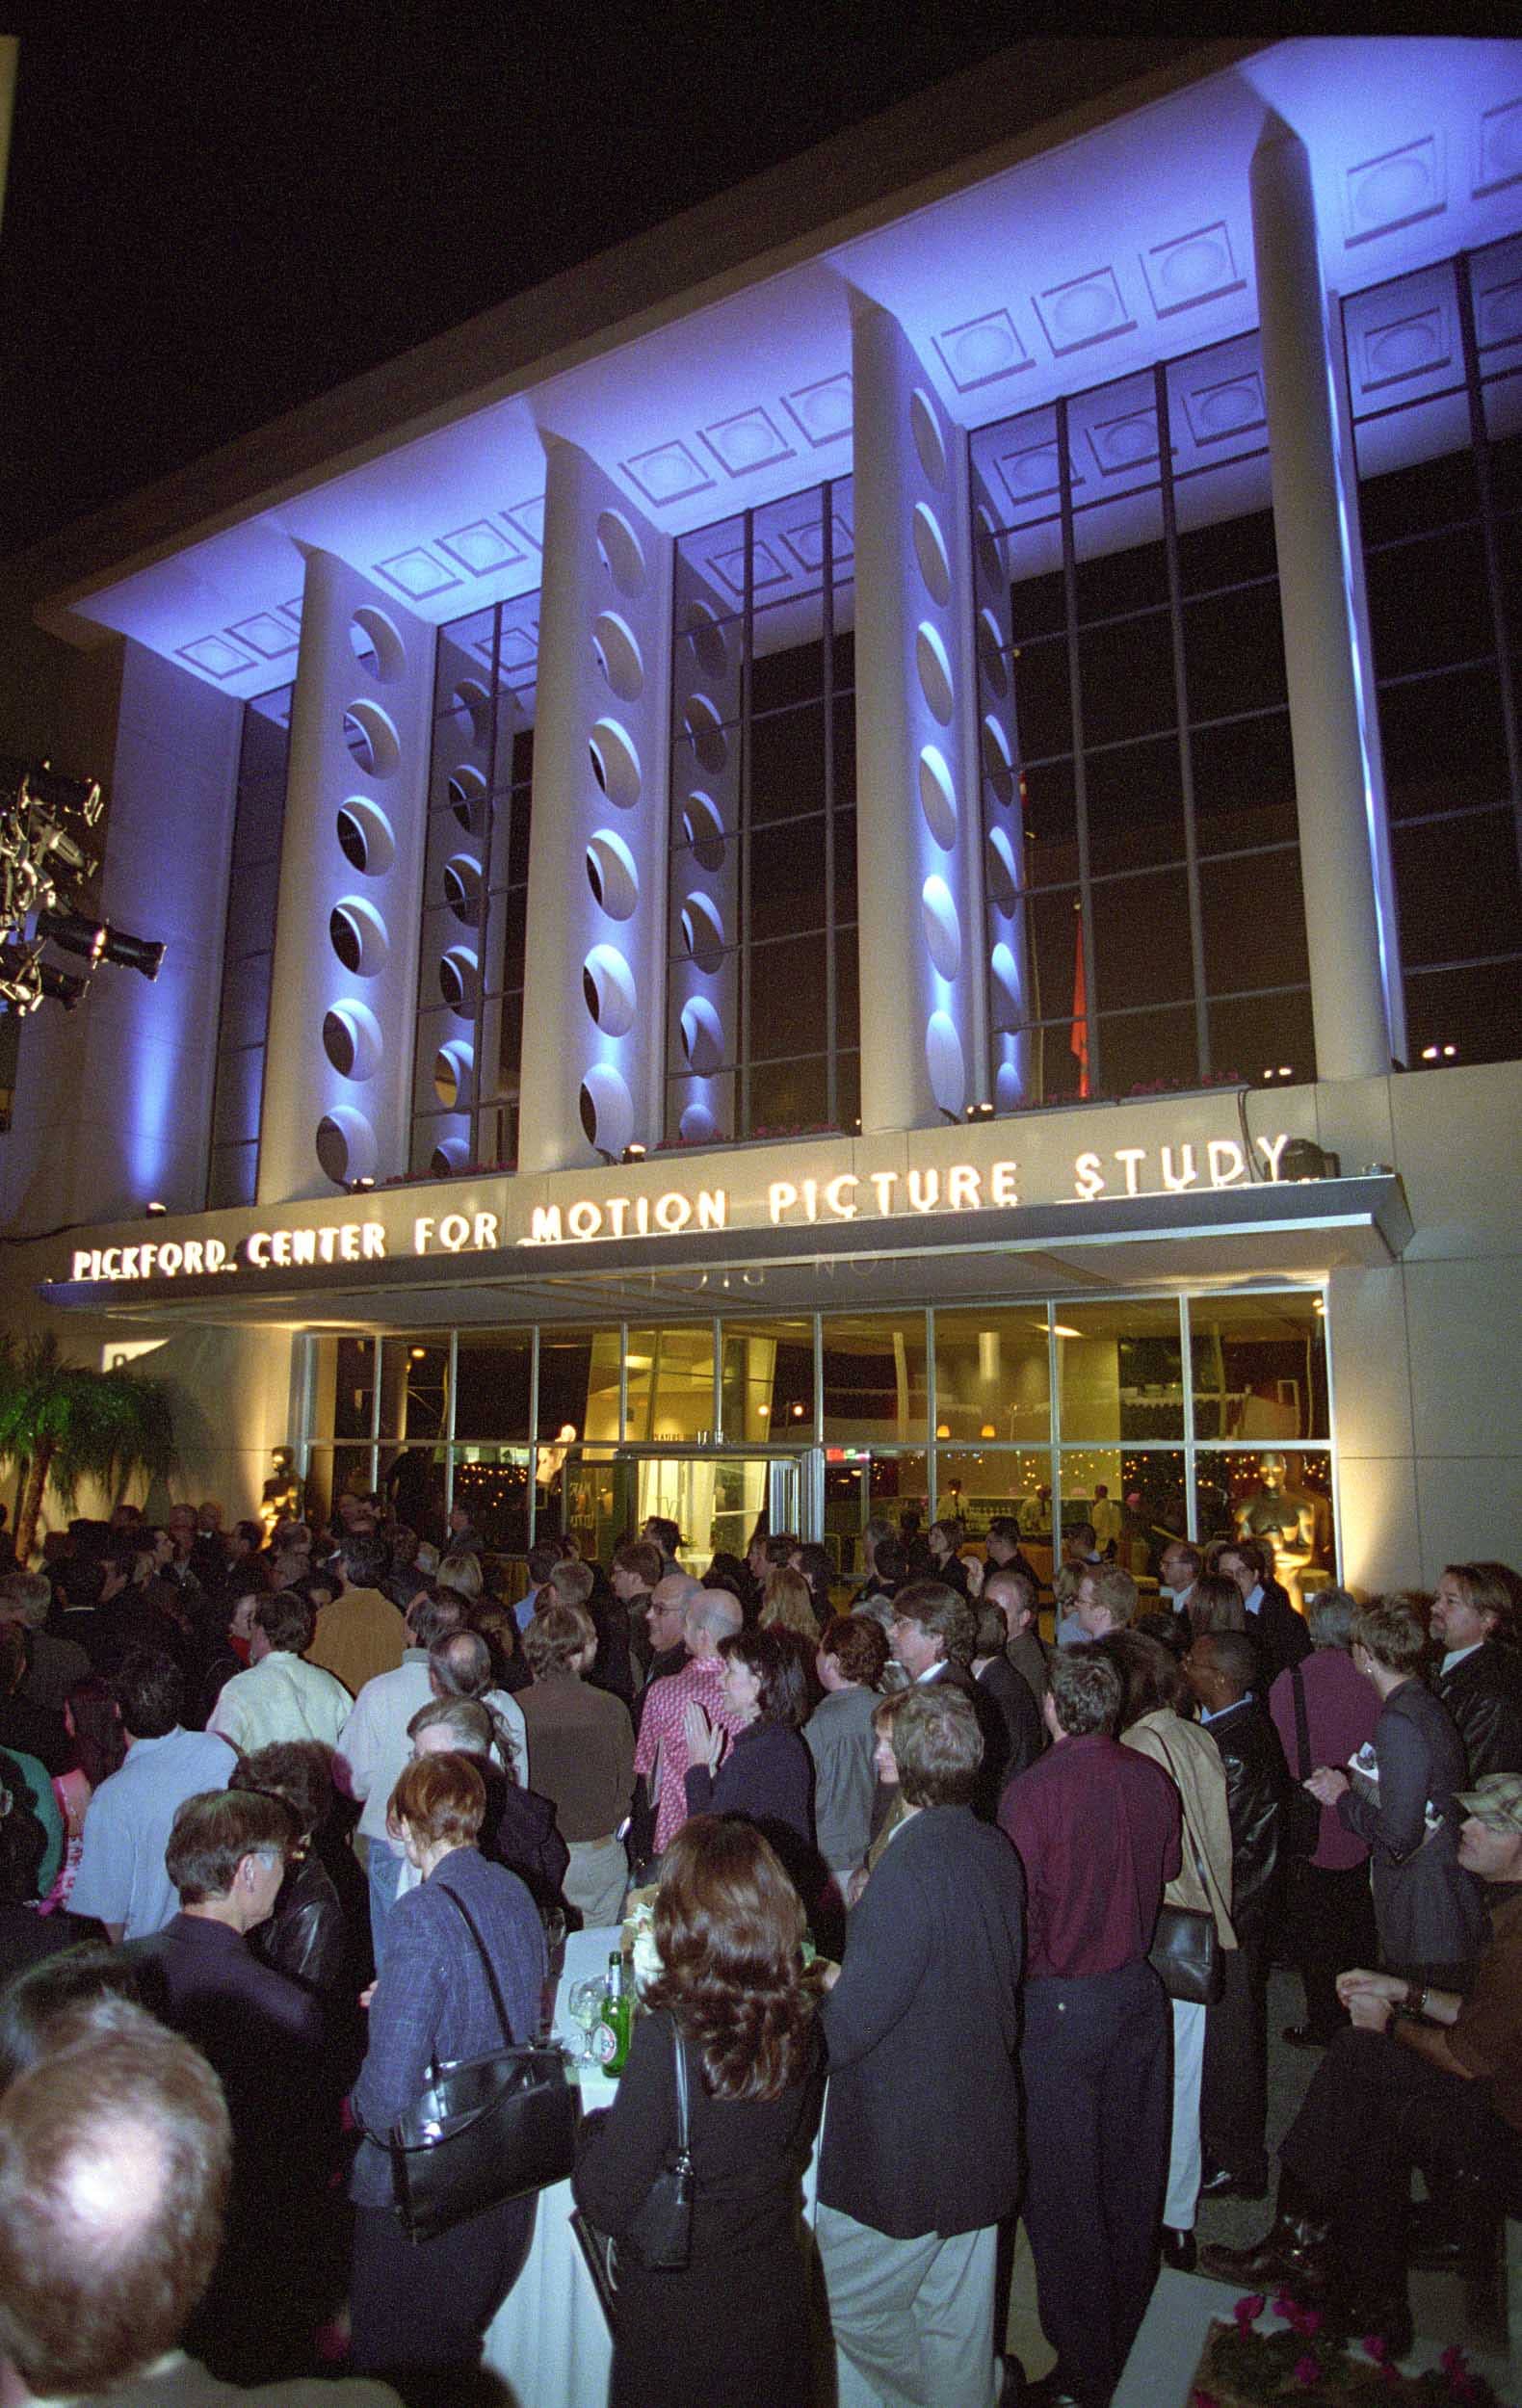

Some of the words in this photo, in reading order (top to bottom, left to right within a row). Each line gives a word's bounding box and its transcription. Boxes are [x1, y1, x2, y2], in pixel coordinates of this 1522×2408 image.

[72, 1241, 227, 1280] PICKFORD
[247, 1223, 386, 1269] CENTER
[414, 1212, 499, 1255] FOR
[532, 1190, 726, 1243] MOTION
[770, 1162, 1017, 1224] PICTURE
[1074, 1135, 1289, 1200] STUDY
